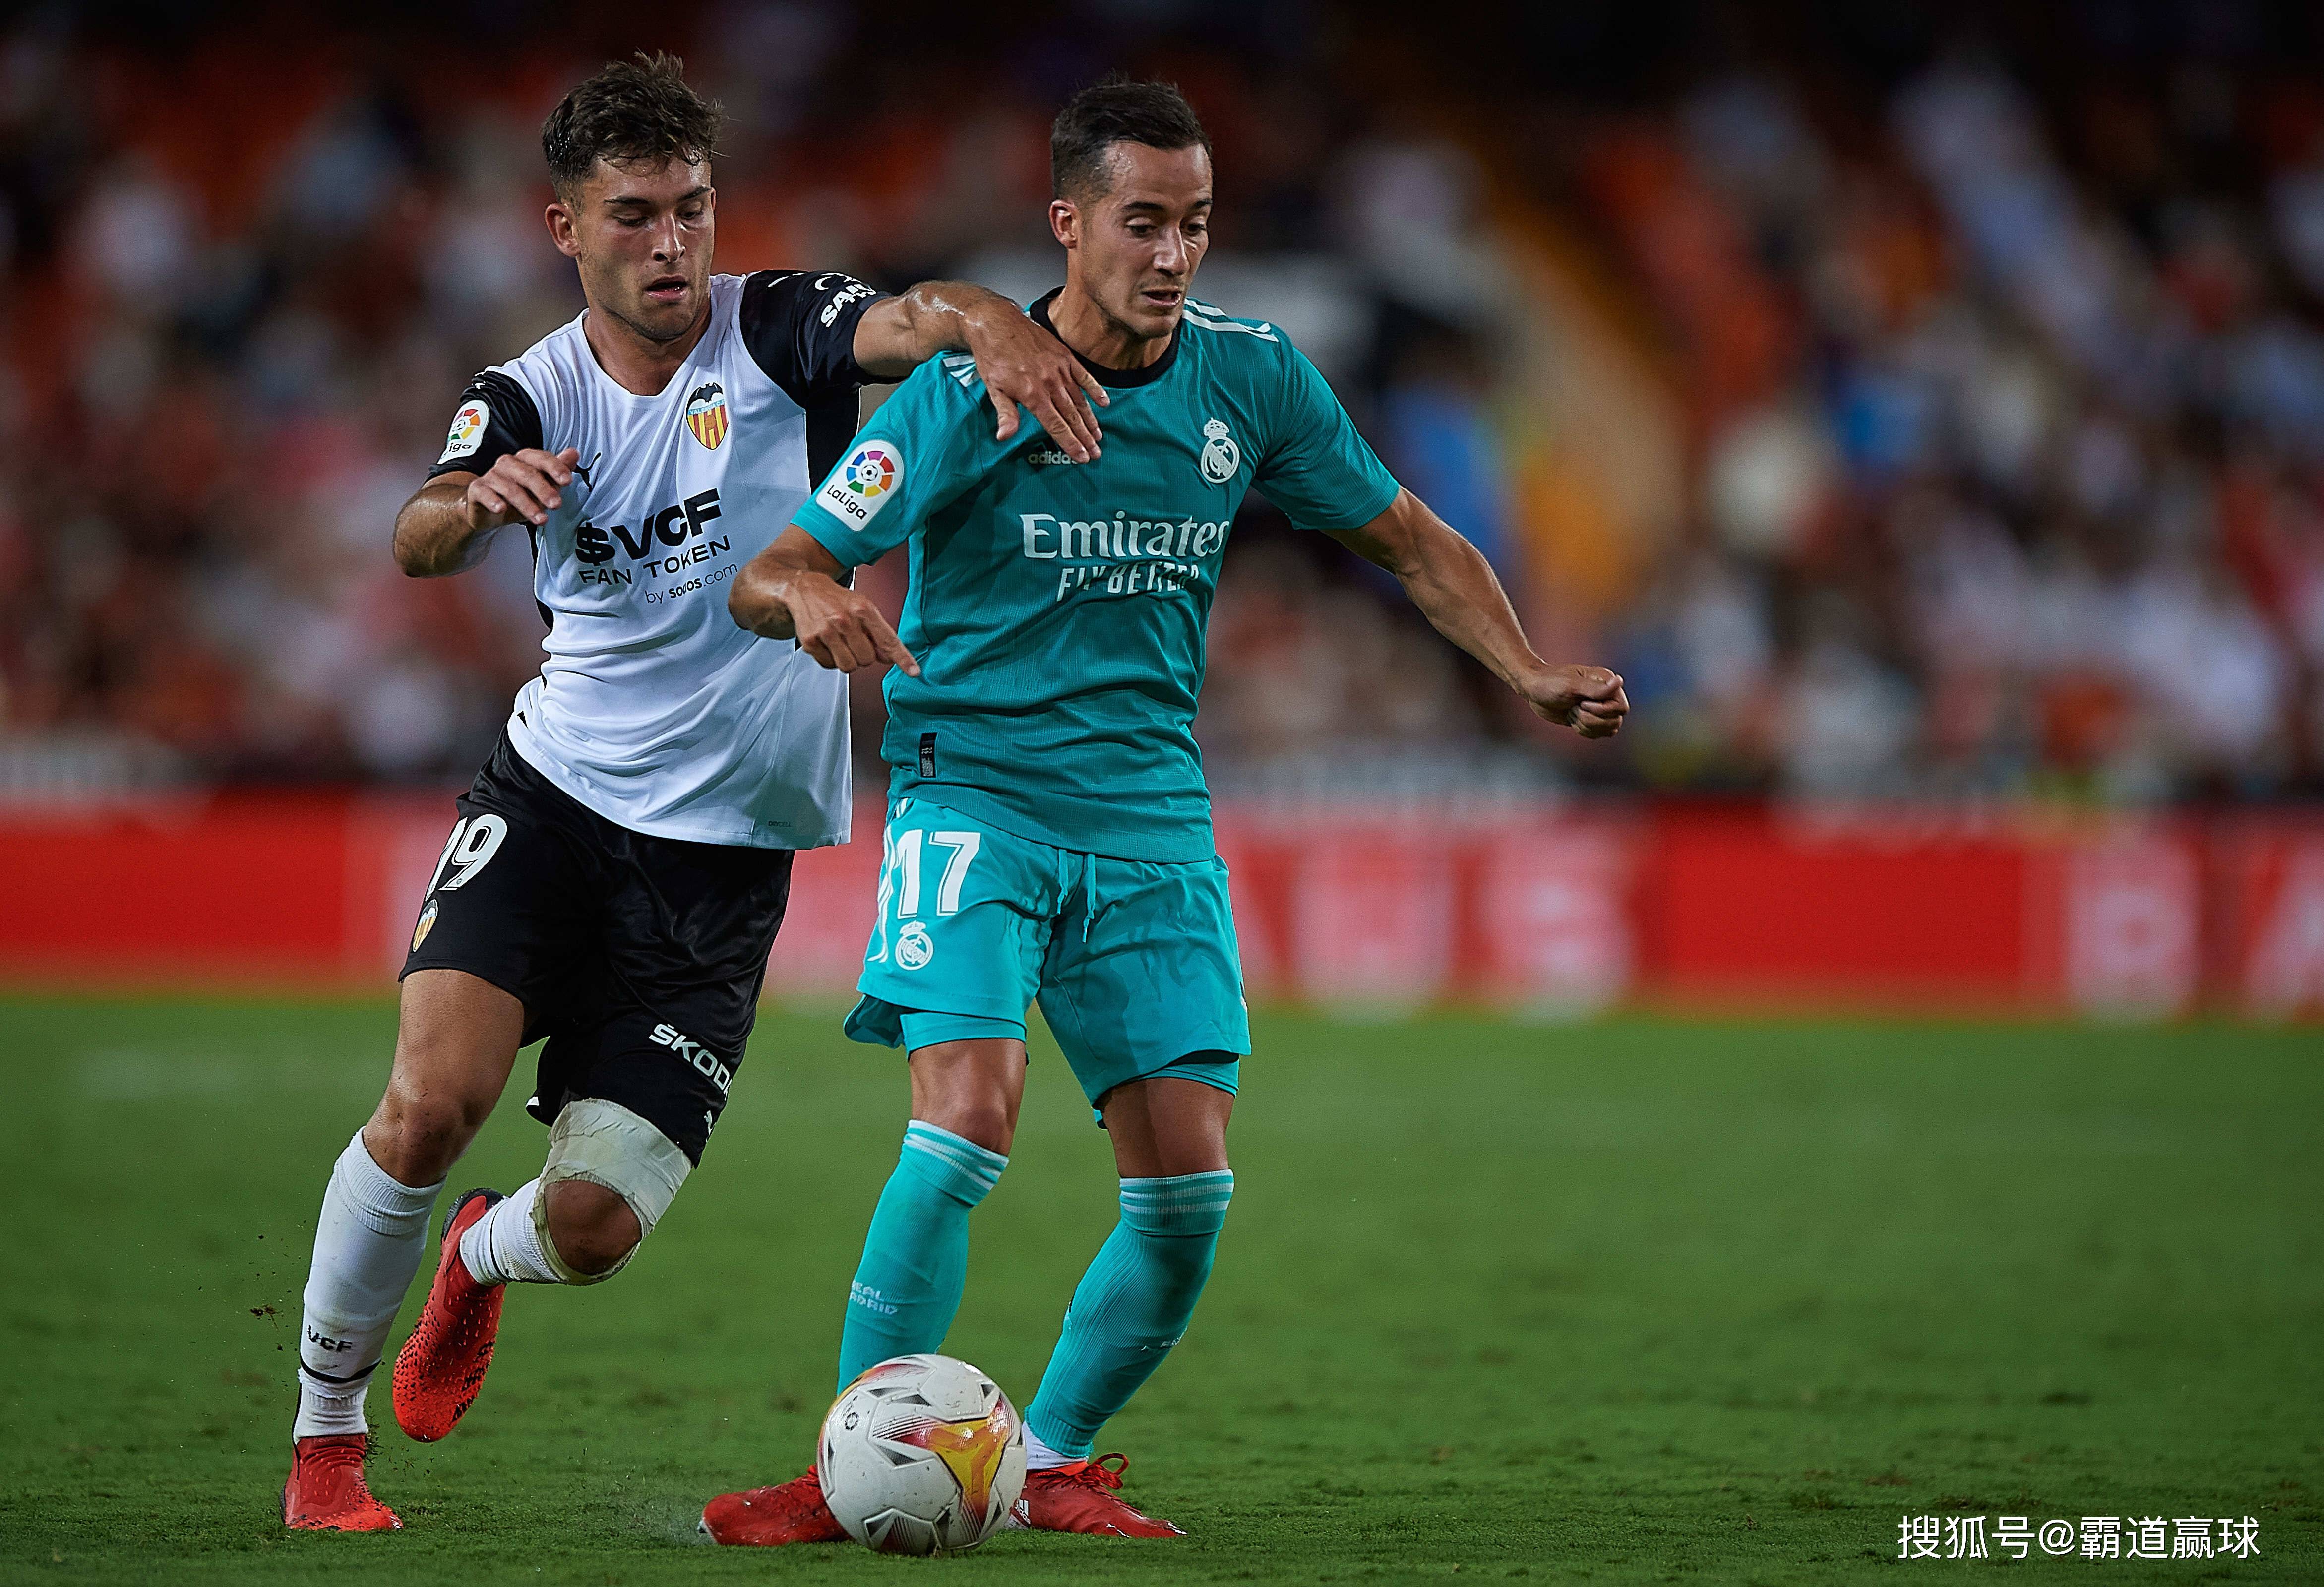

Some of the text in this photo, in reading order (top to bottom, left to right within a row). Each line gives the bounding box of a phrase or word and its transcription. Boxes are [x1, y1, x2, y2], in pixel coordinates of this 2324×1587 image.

[827, 484, 867, 520] LaLiga
[575, 488, 722, 567] $VCF
[1019, 511, 1230, 559] Emirates
[578, 535, 731, 585] FAN TOKEN
[645, 590, 664, 604] by
[893, 829, 981, 919] 17
[849, 1292, 898, 1315] ADRID
[307, 1324, 353, 1352] VCF
